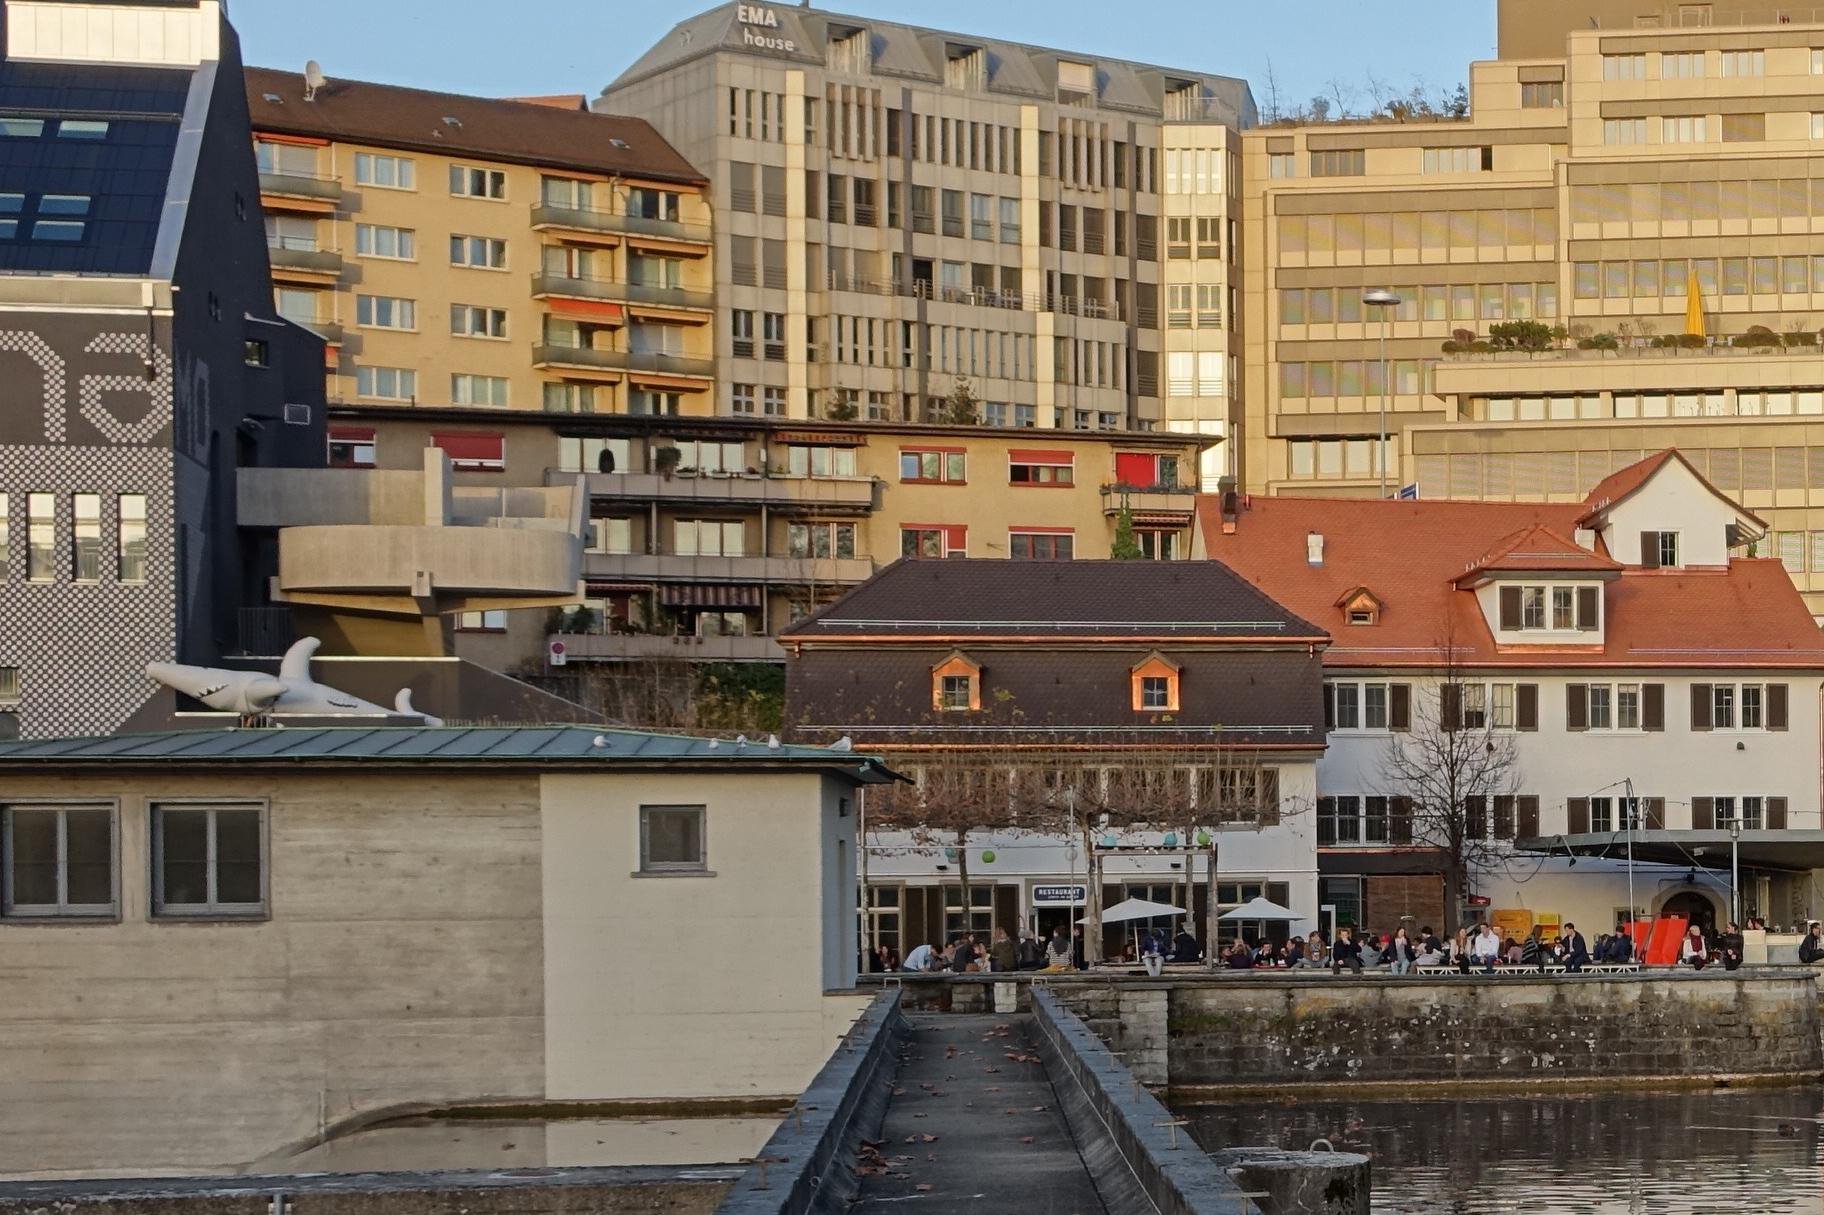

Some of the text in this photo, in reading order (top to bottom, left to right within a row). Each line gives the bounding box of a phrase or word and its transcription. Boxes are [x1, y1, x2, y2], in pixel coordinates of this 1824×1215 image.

[738, 5, 778, 27] EMA
[744, 27, 794, 51] house
[1038, 888, 1080, 896] RESTAURANT
